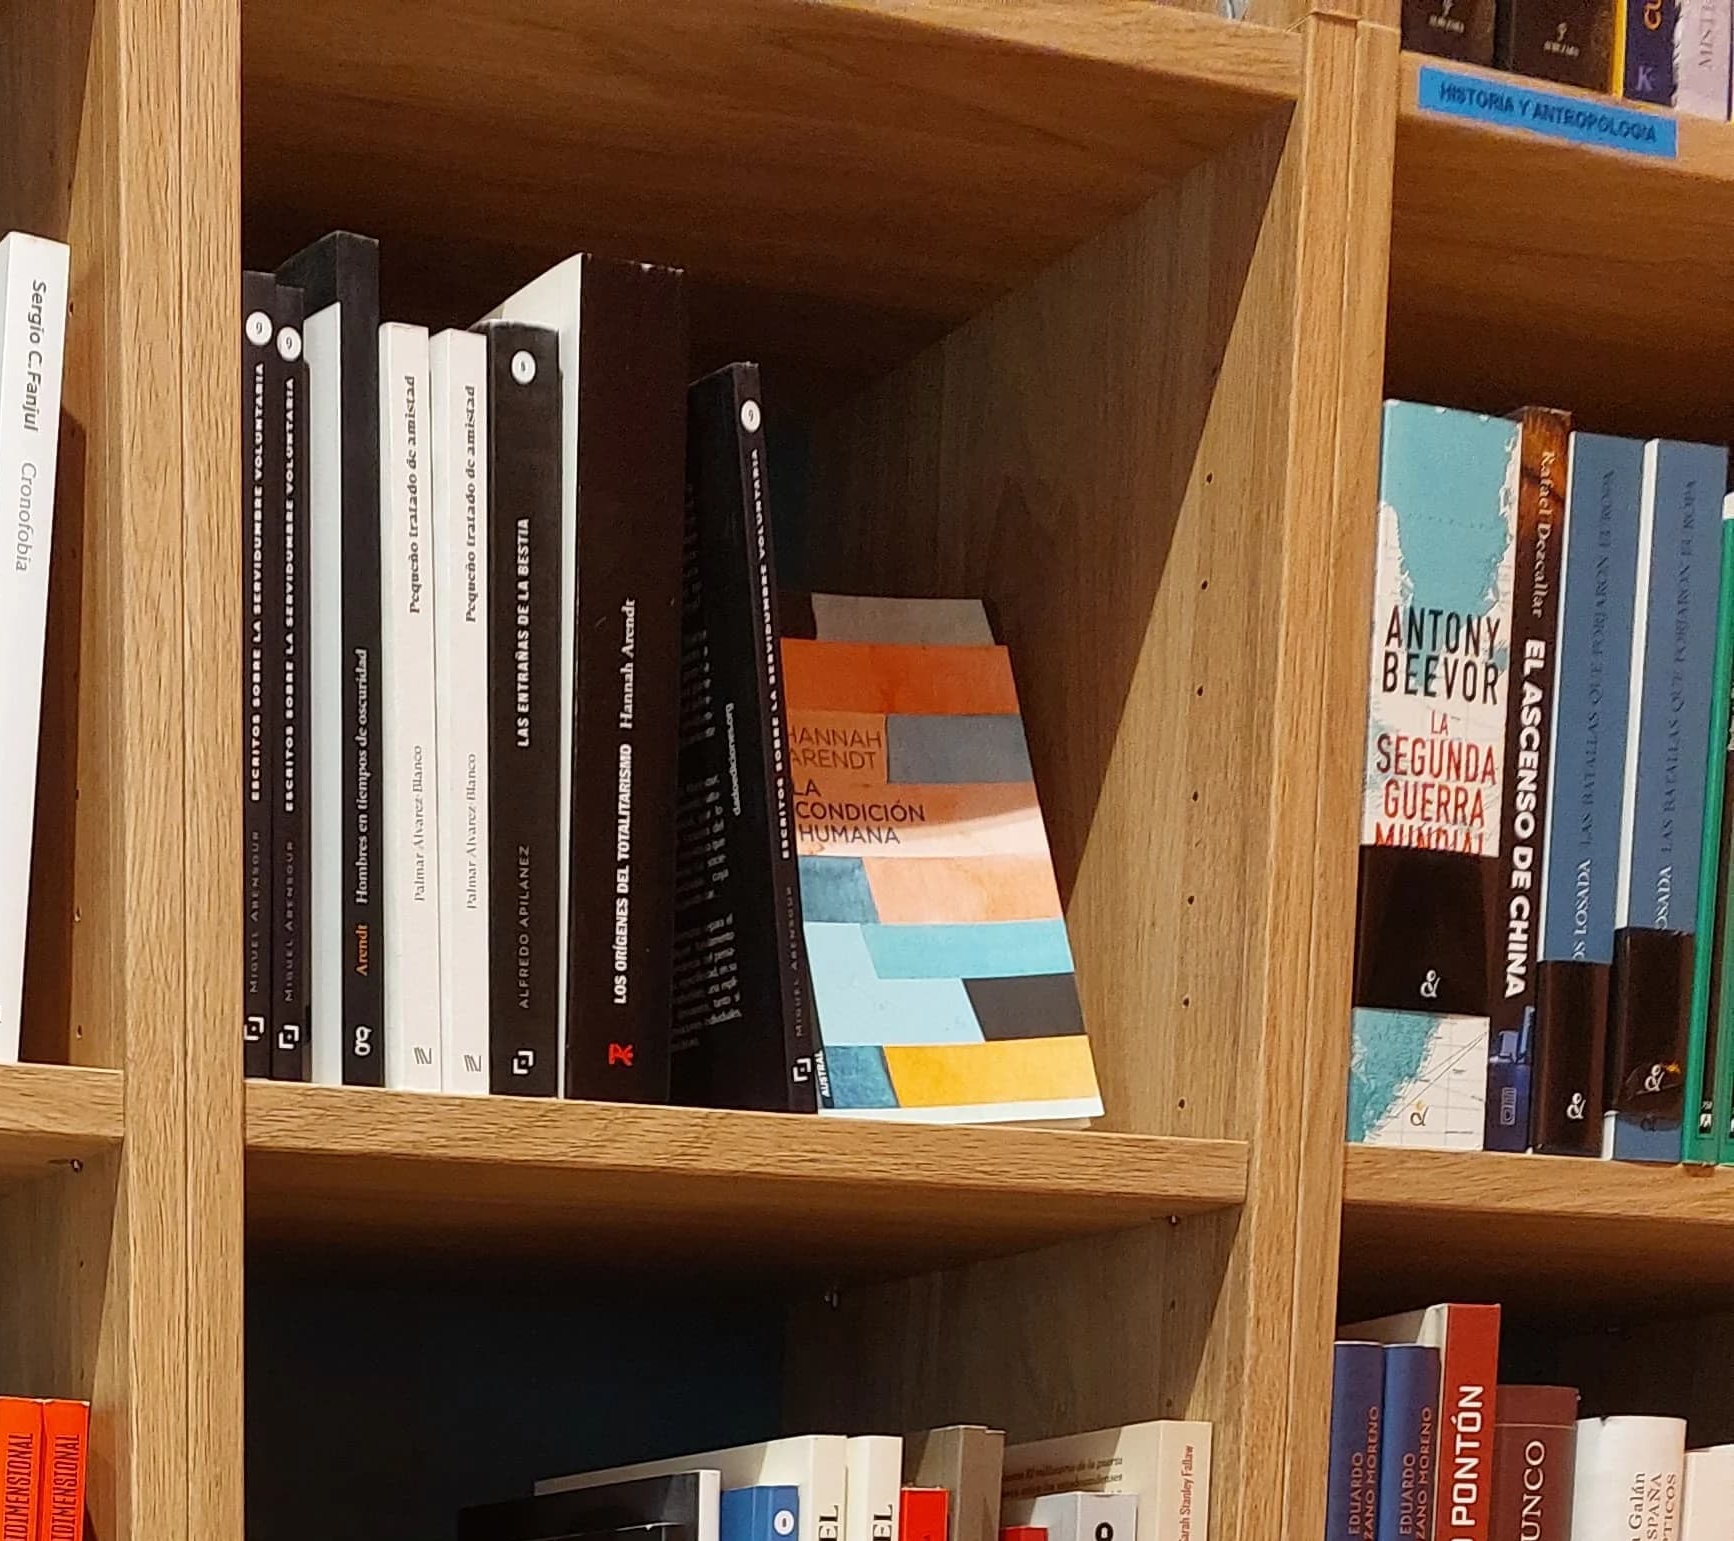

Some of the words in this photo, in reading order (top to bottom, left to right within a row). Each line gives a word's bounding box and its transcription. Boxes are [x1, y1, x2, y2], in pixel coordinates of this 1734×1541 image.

[1440, 83, 1513, 111] HISTORIA
[1521, 100, 1529, 115] Y
[1532, 103, 1654, 140] ANTROPOLOGIA
[621, 598, 634, 657] Arendt
[1386, 604, 1502, 659] ANTONY
[619, 662, 633, 728] Hannah
[1381, 652, 1499, 706] BEEVOR
[1431, 709, 1449, 735] LA
[1376, 734, 1497, 787] SEGUNDA
[617, 743, 631, 860] TOTALITARISMO
[794, 800, 924, 821] CONDICIÓN
[1384, 779, 1485, 829] GUERRA
[797, 823, 900, 846] HUMANA
[616, 865, 628, 893] DEL
[612, 897, 628, 971] ORÍGENES
[614, 975, 626, 1003] LOS
[1451, 1386, 1482, 1525] PONTÓN
